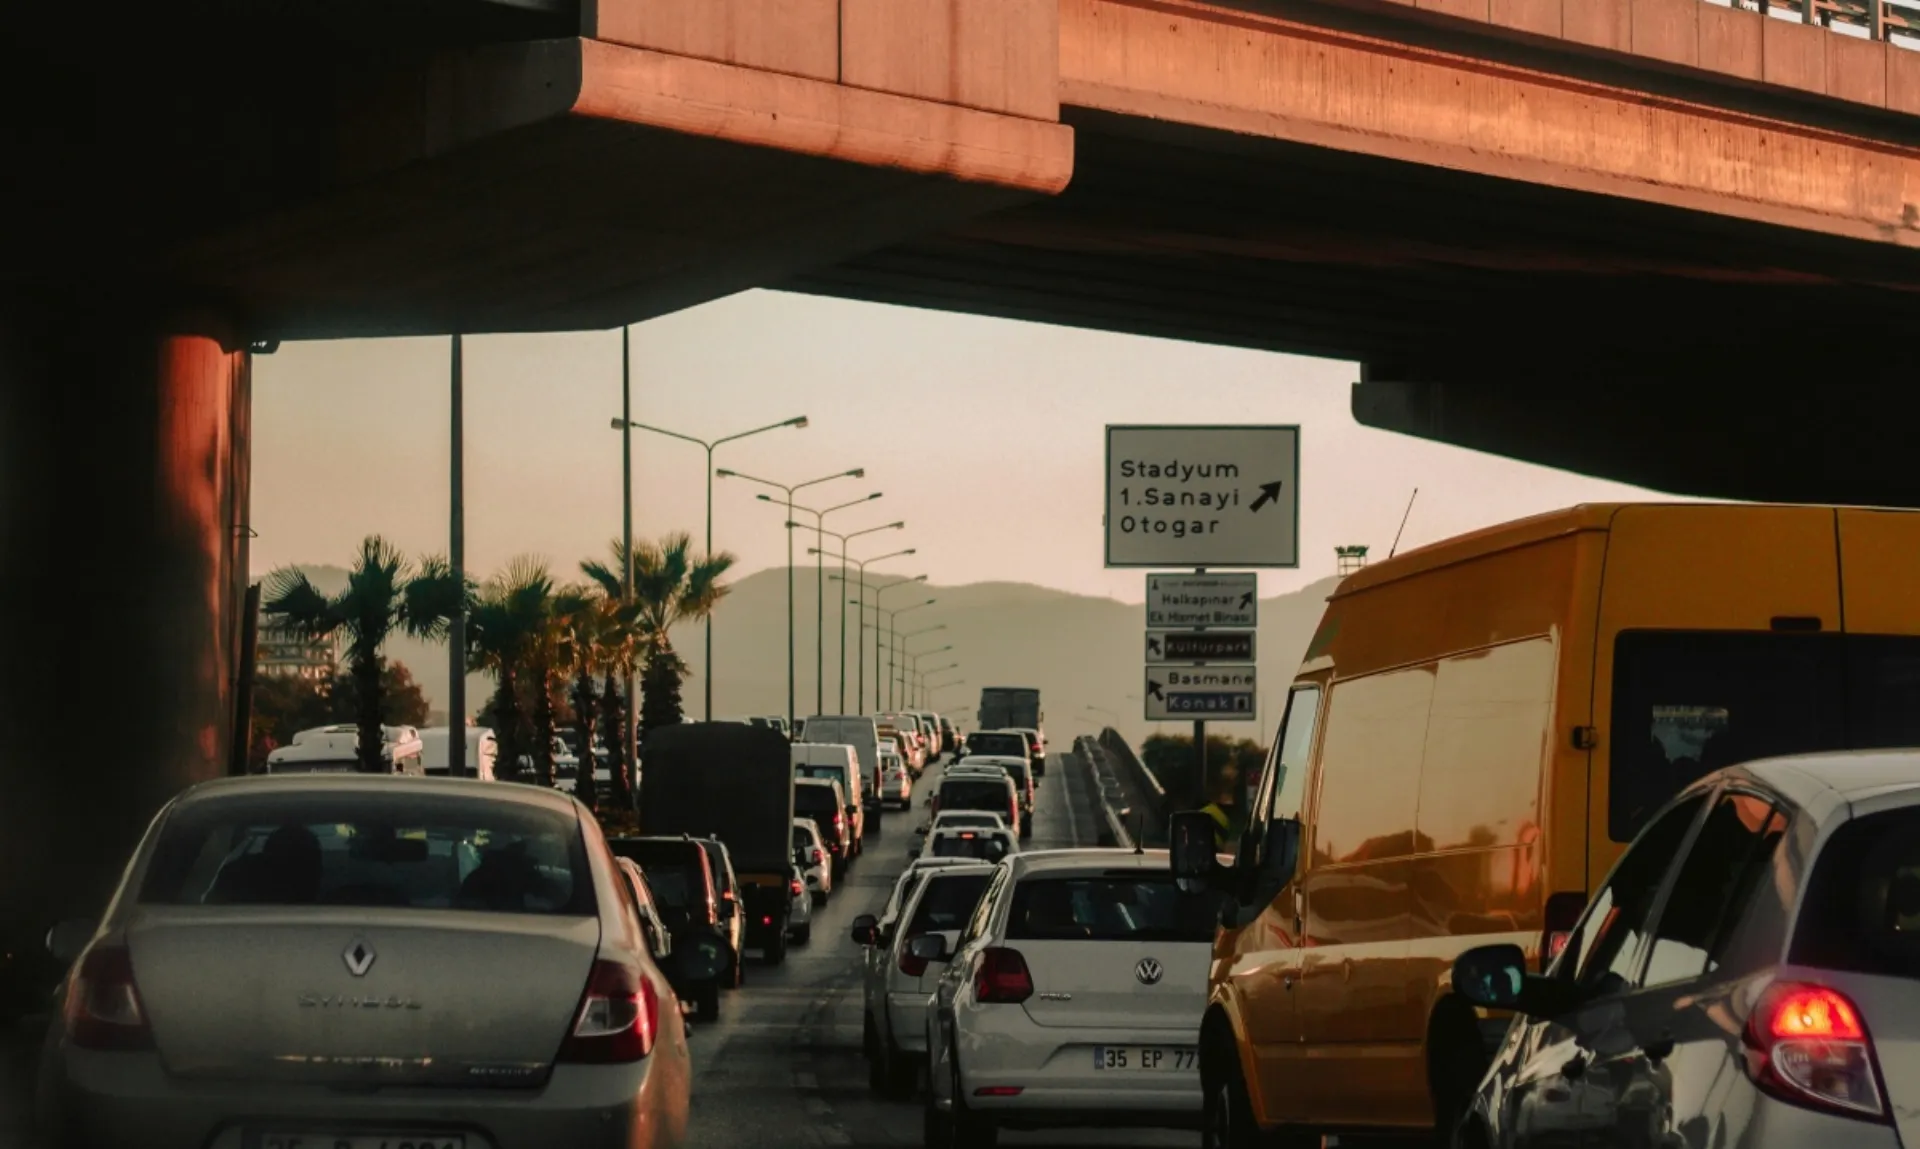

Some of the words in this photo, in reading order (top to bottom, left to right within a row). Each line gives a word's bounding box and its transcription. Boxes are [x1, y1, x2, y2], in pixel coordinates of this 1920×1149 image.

[1120, 459, 1239, 483] Stadyum
[1120, 487, 1240, 511] 1.Sanayi
[1120, 515, 1220, 538] Otogar
[1168, 672, 1254, 685] Basmane
[1169, 696, 1229, 709] Konak
[1106, 1049, 1127, 1068] 35
[1141, 1049, 1163, 1068] EP
[1174, 1050, 1201, 1069] 77
